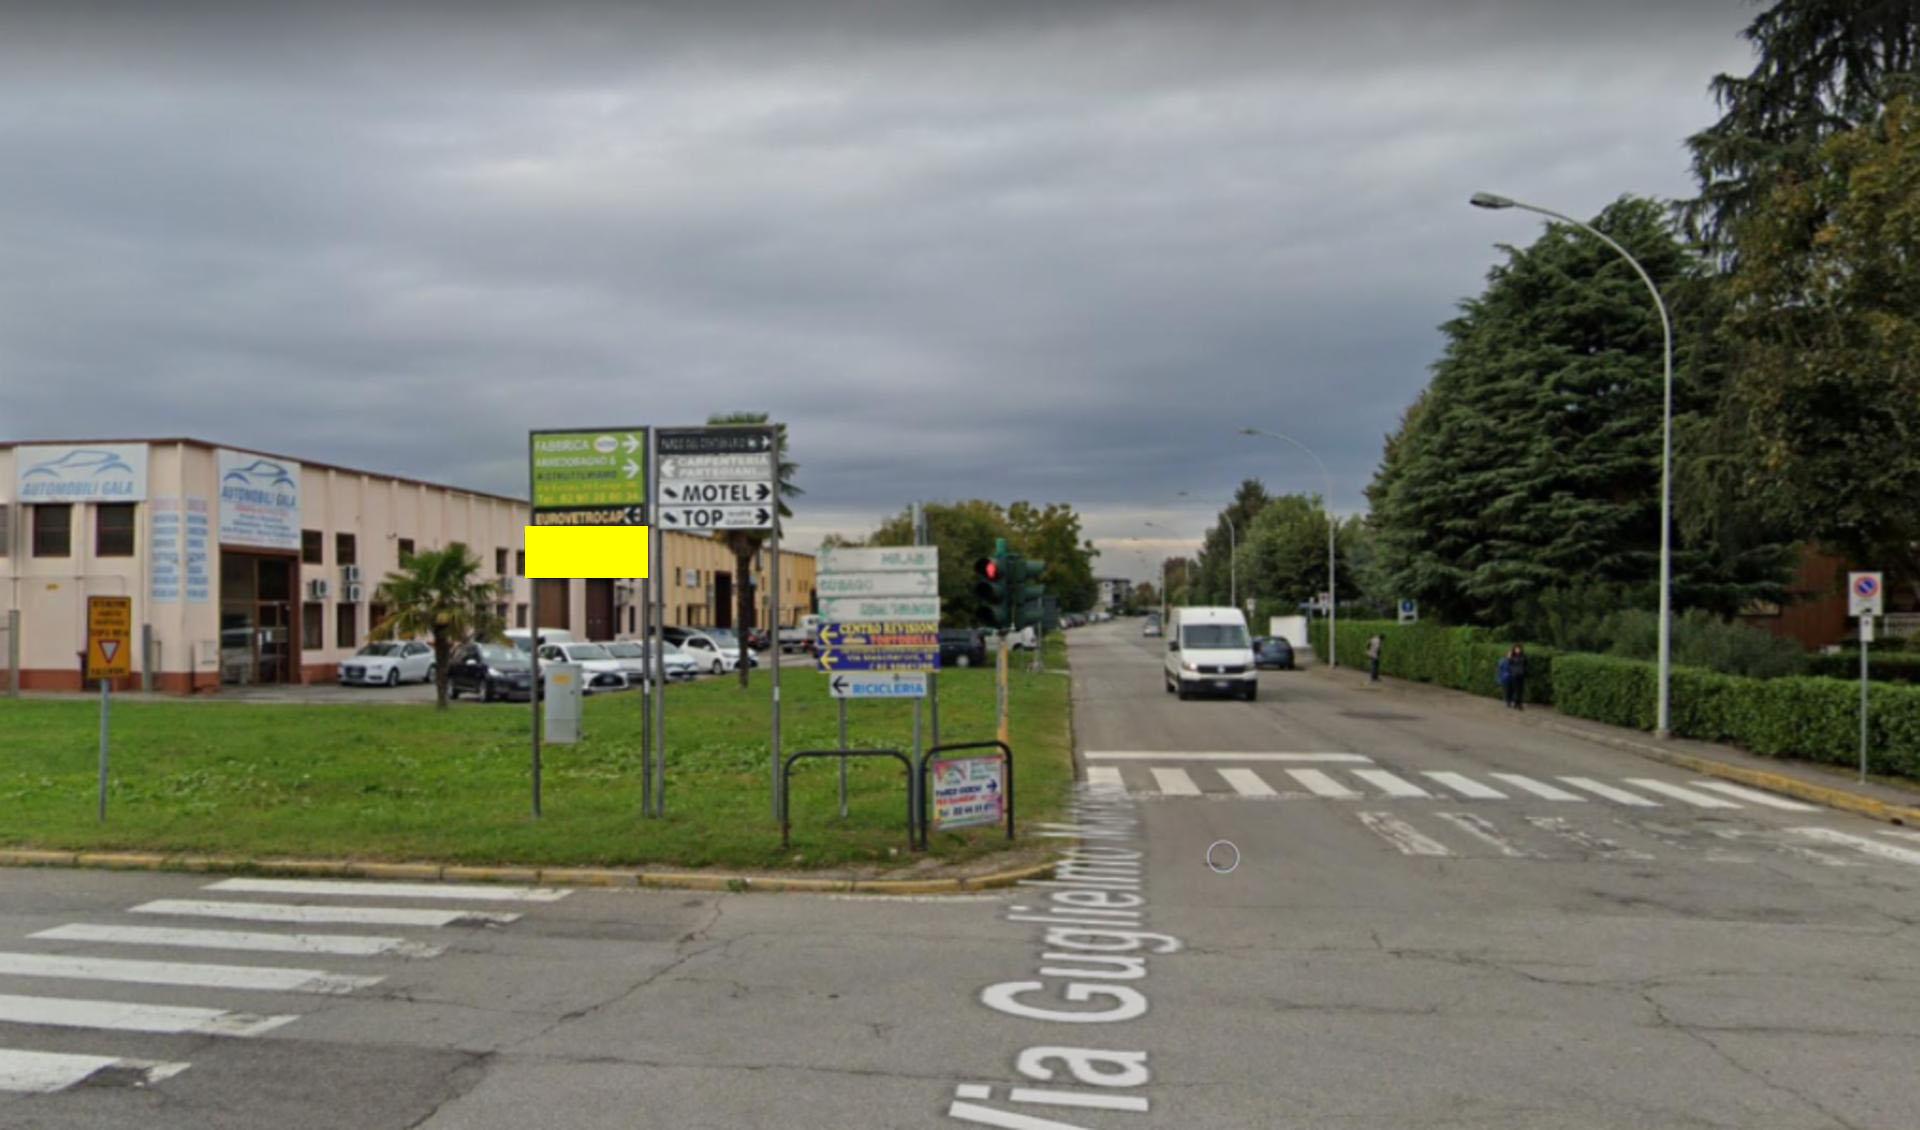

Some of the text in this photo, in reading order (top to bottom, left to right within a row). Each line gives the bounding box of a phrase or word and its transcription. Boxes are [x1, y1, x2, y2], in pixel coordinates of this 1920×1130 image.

[535, 440, 590, 453] FABBRICA
[677, 455, 769, 467] CARPENTERIA
[22, 480, 134, 496] AUTOMOBILI GALA
[682, 484, 752, 502] MOTEL
[222, 486, 274, 504] AUTOMOBILI
[276, 492, 296, 507] GALA
[682, 509, 724, 526] TOP
[839, 623, 937, 634] CENTRO REVISIONI
[852, 682, 924, 694] RICICLERIA
